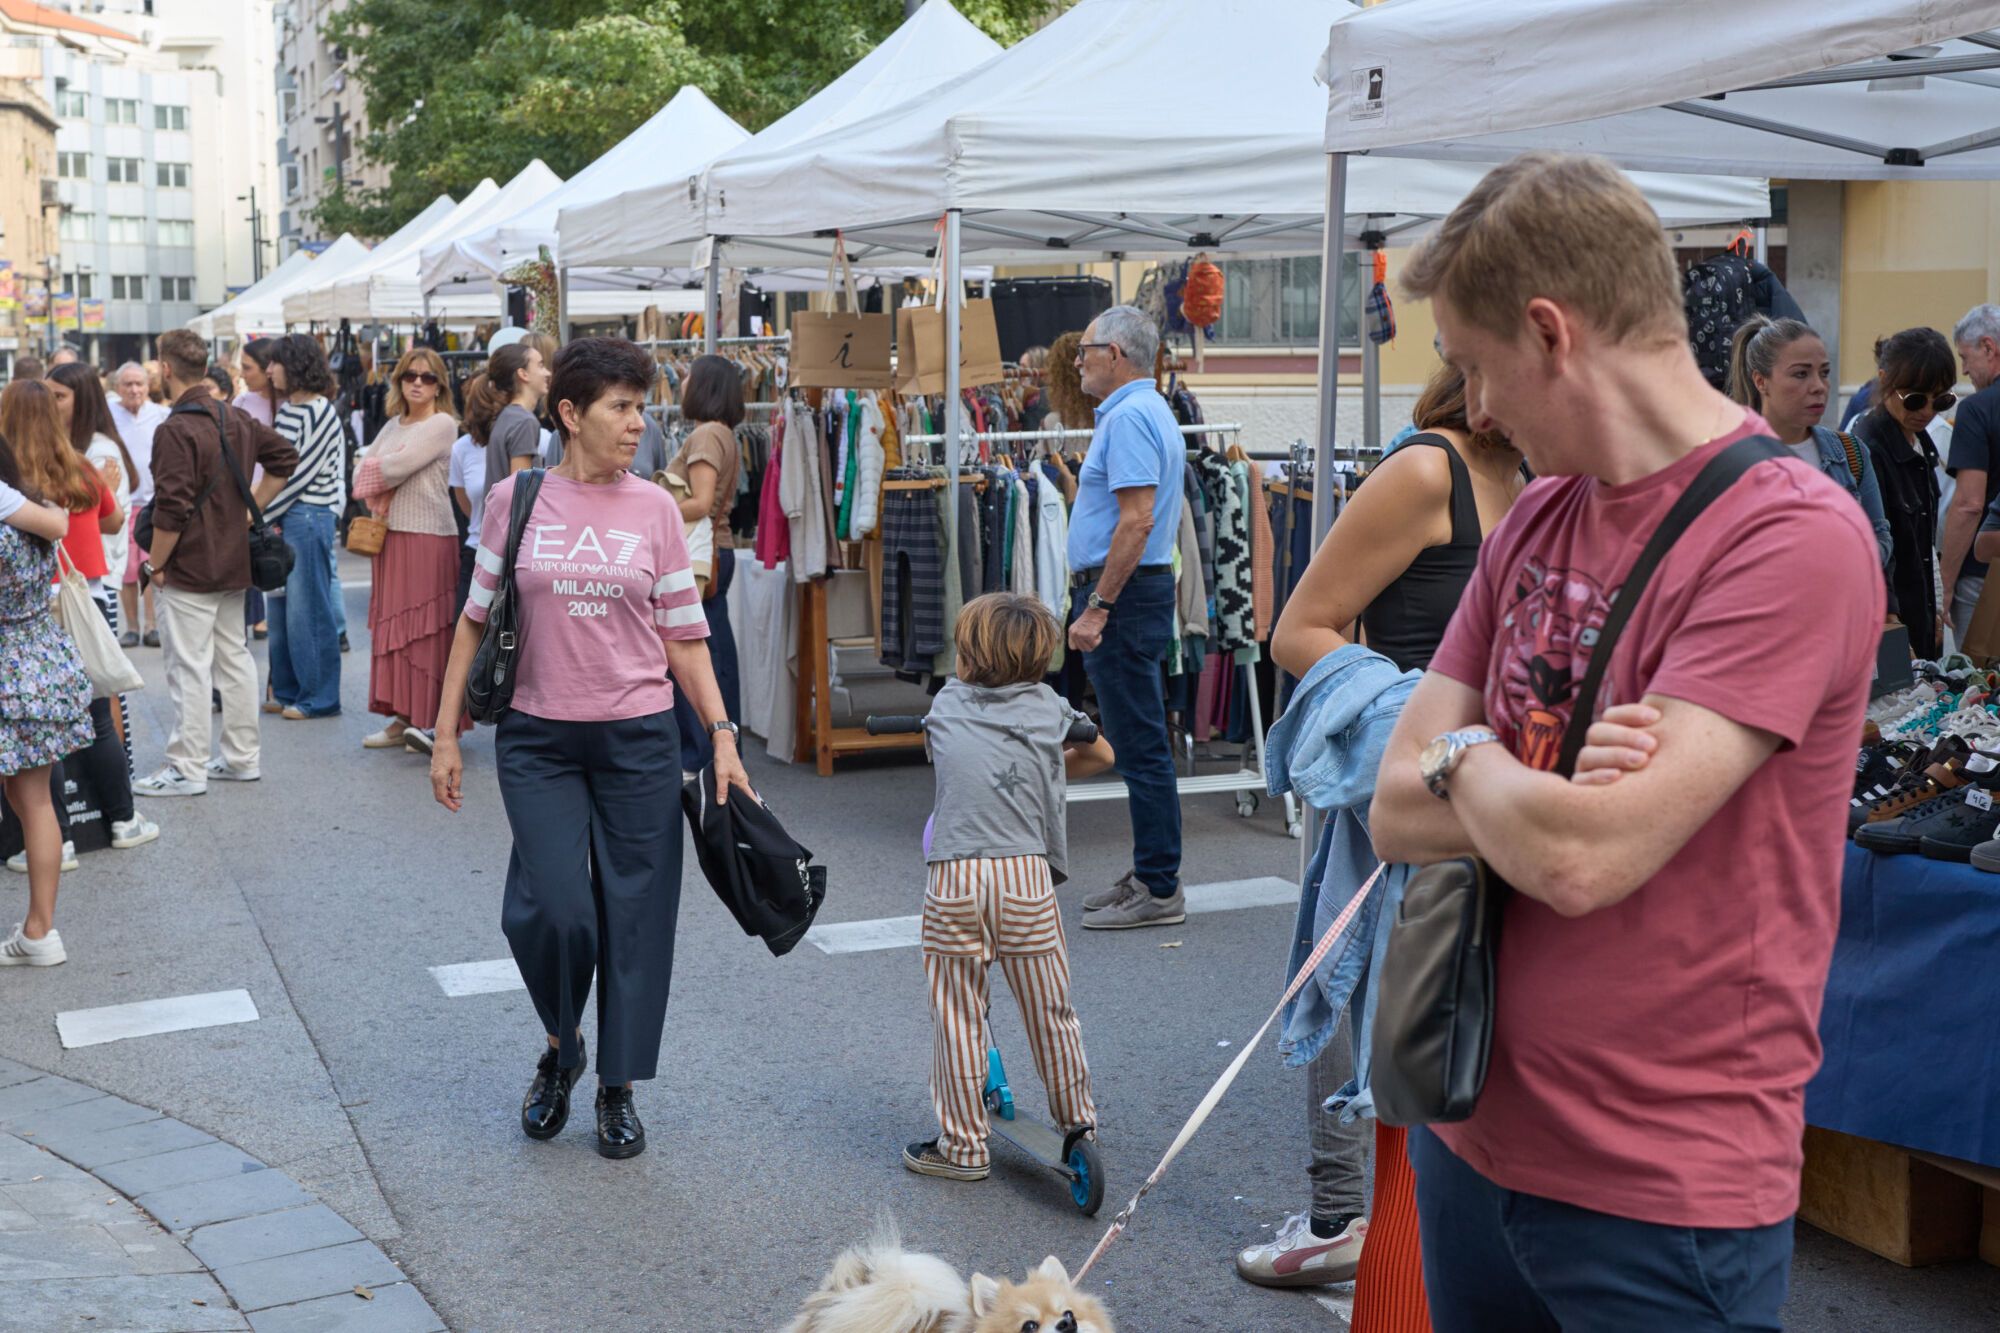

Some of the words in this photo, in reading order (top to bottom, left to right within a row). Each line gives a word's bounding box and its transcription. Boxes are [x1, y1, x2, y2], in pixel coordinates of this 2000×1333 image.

[533, 525, 642, 565] EA7
[531, 561, 586, 574] EMPORIO
[552, 580, 625, 599] MILANO
[567, 602, 608, 617] 2004
